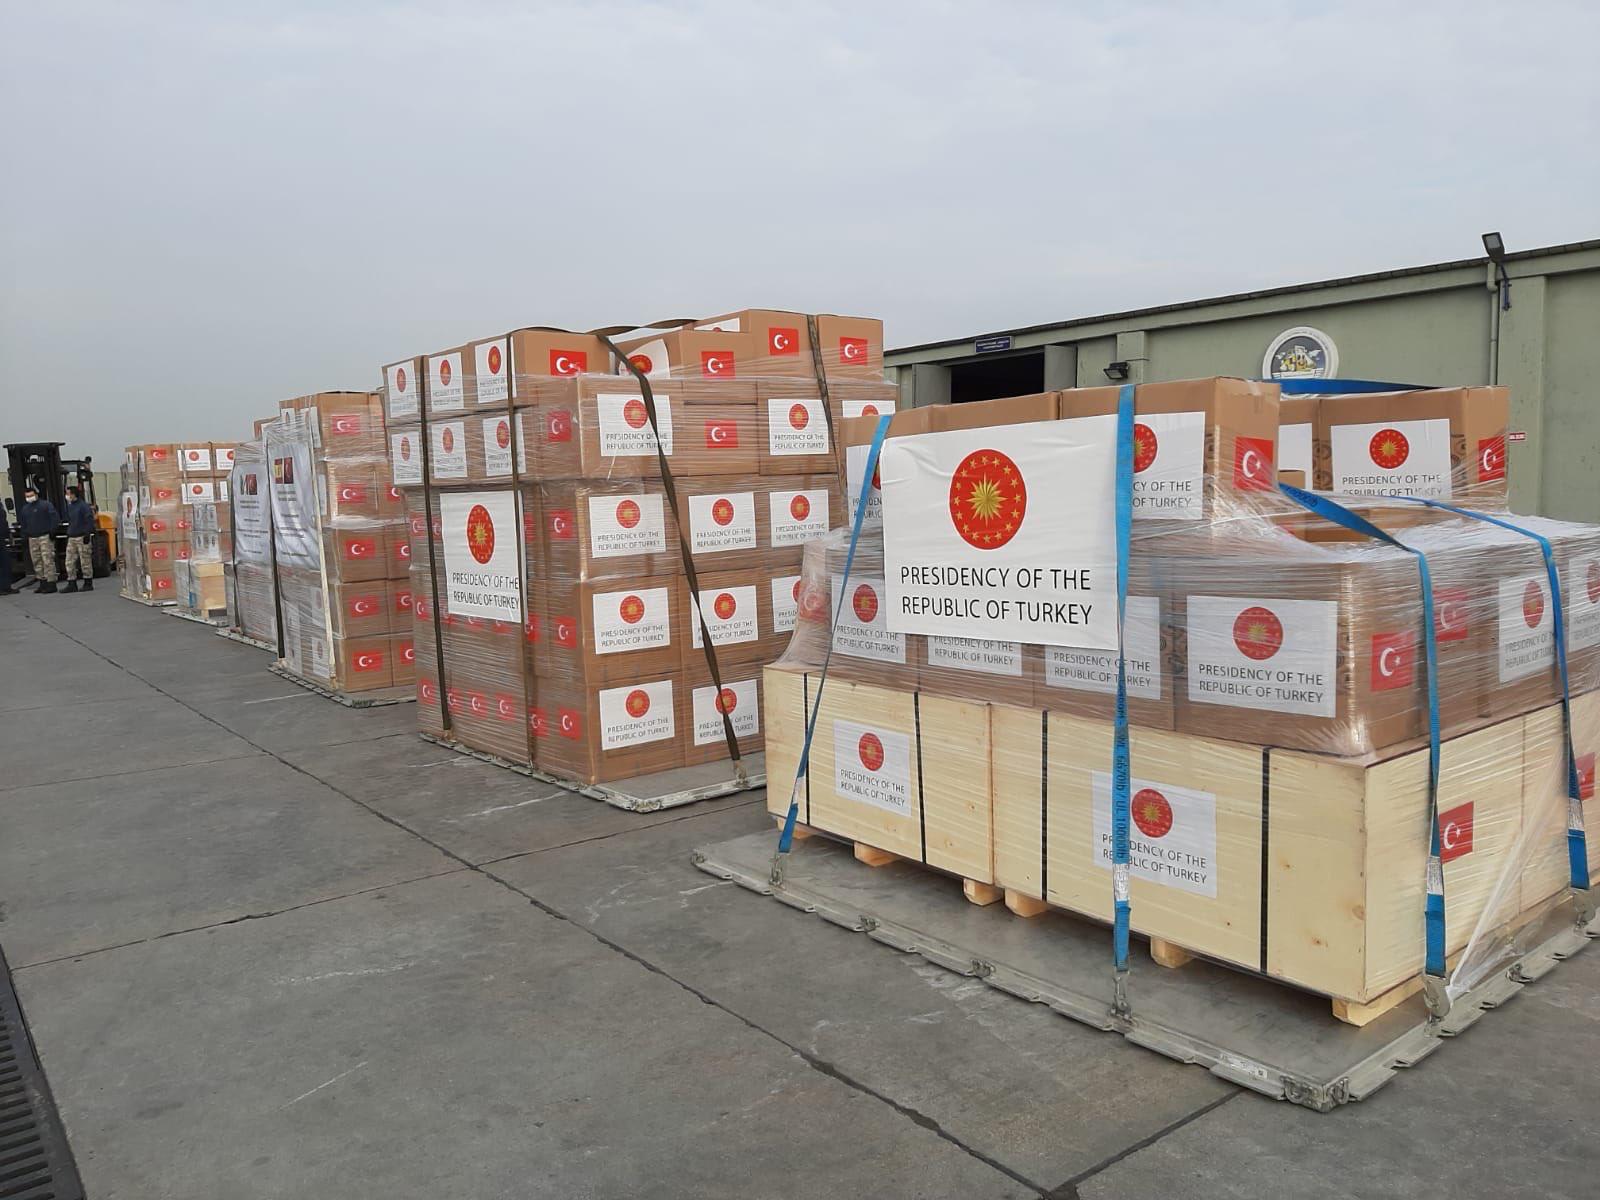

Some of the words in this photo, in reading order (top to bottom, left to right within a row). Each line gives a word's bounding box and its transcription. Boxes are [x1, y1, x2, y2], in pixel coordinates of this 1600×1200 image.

[1151, 481, 1167, 491] OF
[1169, 480, 1192, 491] THE
[1342, 476, 1403, 485] PRESIDENCY
[1405, 475, 1419, 484] OF
[1389, 488, 1404, 497] OF
[1133, 497, 1147, 508] OF
[1150, 497, 1192, 508] TURKEY
[452, 572, 492, 587] PRESIDENCY
[494, 575, 504, 588] OF
[505, 576, 520, 590] THE
[900, 566, 1010, 588] PRESIDENCY
[1016, 568, 1043, 589] OF
[1050, 568, 1092, 590] THE
[453, 590, 483, 606] REPUBLIC
[484, 593, 494, 606] OF
[494, 594, 520, 610] TURKEY
[902, 596, 981, 618] REPUBLIC
[986, 599, 1011, 620] OF
[1015, 601, 1092, 625] TURKEY
[836, 625, 874, 639] PRESIDENCY
[875, 630, 885, 639] OF
[885, 631, 899, 641] THE
[836, 637, 864, 649] REPUBLIC
[865, 641, 875, 650] OF
[874, 642, 900, 654] TURKEY
[983, 639, 996, 650] OF
[934, 649, 969, 661] REPUBLIC
[971, 652, 982, 662] OF
[983, 653, 1014, 666] TURKEY
[1053, 652, 1112, 667] PRESIDENCY
[1131, 660, 1151, 672] THE
[1054, 666, 1097, 681] REPUBLIC
[1098, 671, 1112, 683] OF
[1114, 673, 1151, 688] TRKEY
[1198, 663, 1273, 682] PRESIDENCY
[1276, 671, 1294, 682] OF
[1297, 672, 1323, 686] THE
[1199, 680, 1252, 697] REPUBLIC
[1255, 686, 1273, 698] OF
[1275, 688, 1324, 703] TURKEY
[841, 769, 879, 787] PRESIDENCY
[880, 780, 890, 790] OF
[892, 783, 905, 795] THE
[840, 781, 869, 797] REPUBLIC
[870, 789, 879, 799] OF
[880, 792, 905, 807] TURKEY
[1167, 850, 1182, 861] OF
[1185, 854, 1206, 869] THE
[1151, 861, 1165, 872] OF
[1166, 864, 1207, 884] TURKEY
